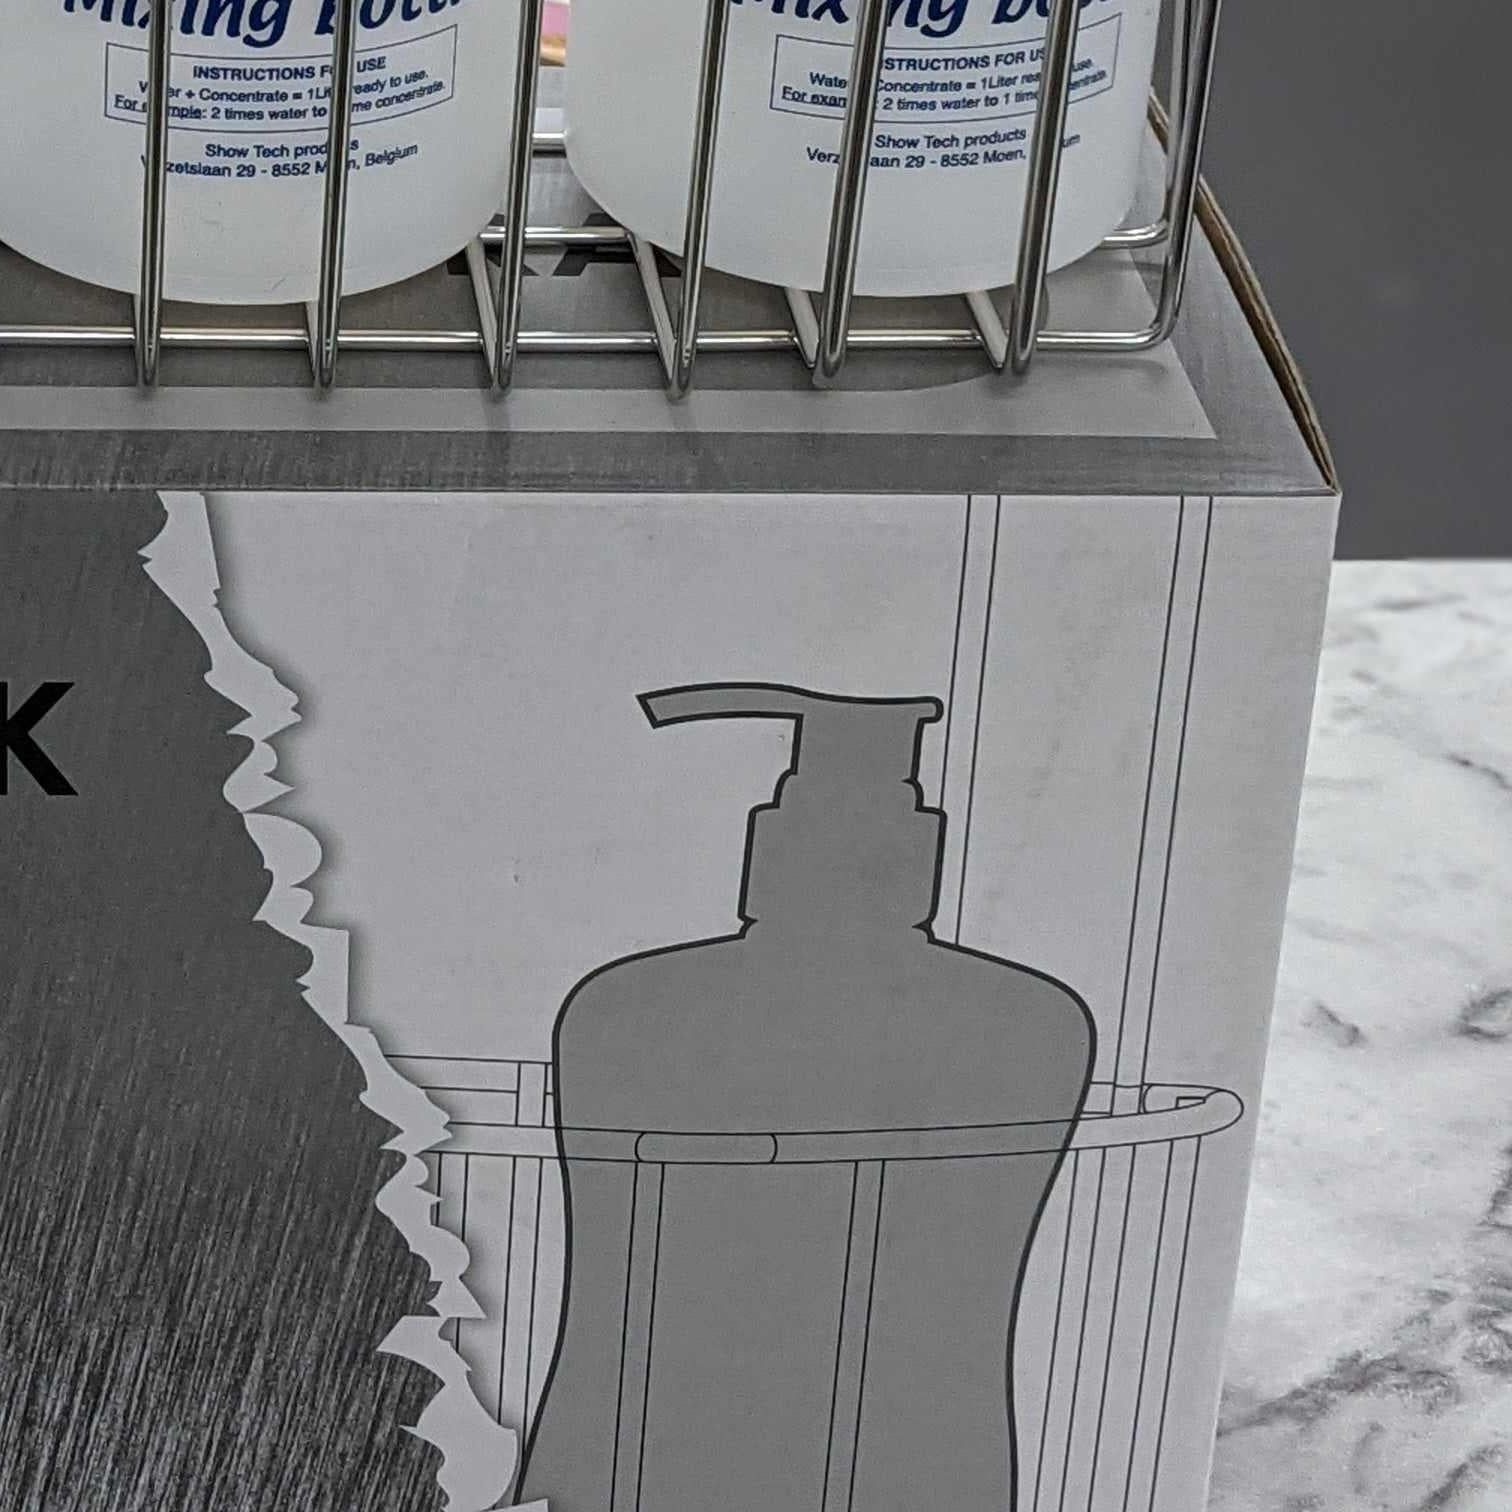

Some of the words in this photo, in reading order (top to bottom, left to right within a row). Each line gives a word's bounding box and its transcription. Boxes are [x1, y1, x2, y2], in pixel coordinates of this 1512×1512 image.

[193, 65, 315, 80] INSTRUCTIONS
[356, 56, 386, 73] USE
[994, 52, 1026, 67] FOR
[199, 88, 288, 103] Concentrate
[389, 76, 401, 87] to
[809, 72, 847, 89] Wate
[114, 94, 138, 110] For
[224, 107, 264, 120] times
[268, 107, 308, 120] water
[312, 106, 327, 117] to
[782, 85, 807, 103] For
[897, 97, 937, 111] times
[941, 97, 980, 110] water
[984, 95, 999, 107] to
[205, 143, 249, 158] Show
[253, 144, 289, 158] Tech
[874, 134, 919, 149] Show
[923, 134, 959, 148] Tech
[963, 128, 1026, 150] products
[236, 164, 255, 177] 29
[271, 162, 310, 176] 8552
[365, 144, 417, 166] Belgium
[904, 155, 925, 168] 29
[940, 153, 978, 167] 8552
